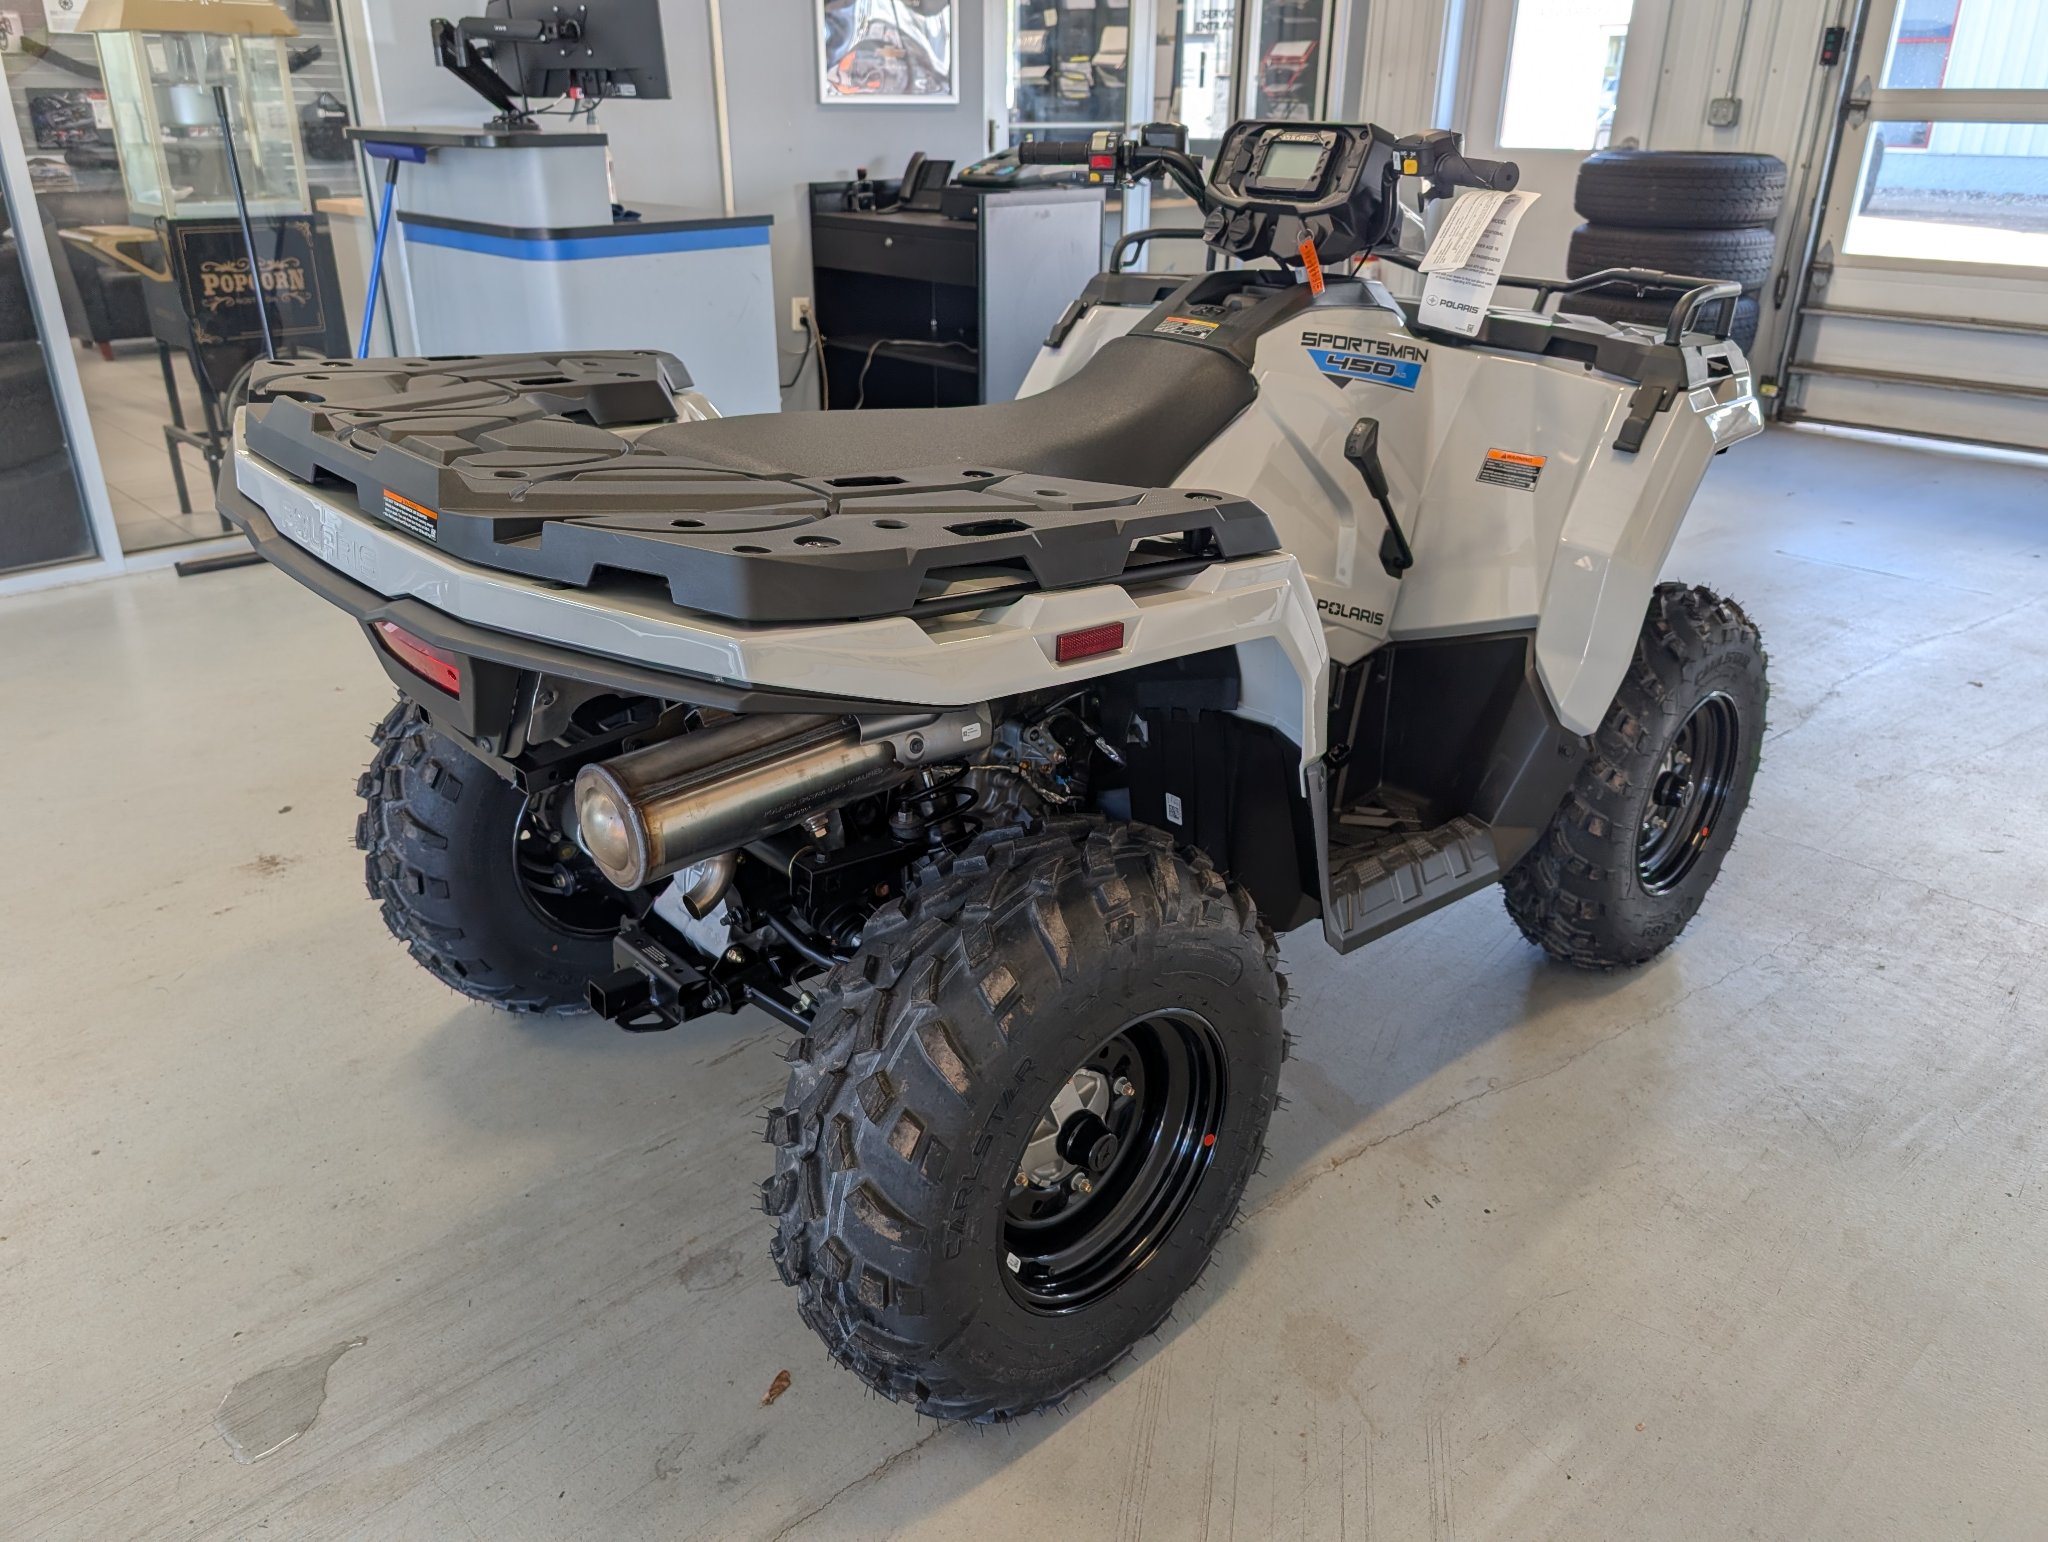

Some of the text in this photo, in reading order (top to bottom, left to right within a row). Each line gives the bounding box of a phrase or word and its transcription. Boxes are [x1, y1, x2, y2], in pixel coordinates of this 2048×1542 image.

[1439, 298, 1480, 314] POLARIS
[1301, 331, 1429, 363] SPORTSMAN
[1326, 354, 1396, 377] 450
[281, 499, 378, 581] POLARIS
[1317, 598, 1384, 626] POLARIS
[945, 1055, 1036, 1260] CARLSTAR
